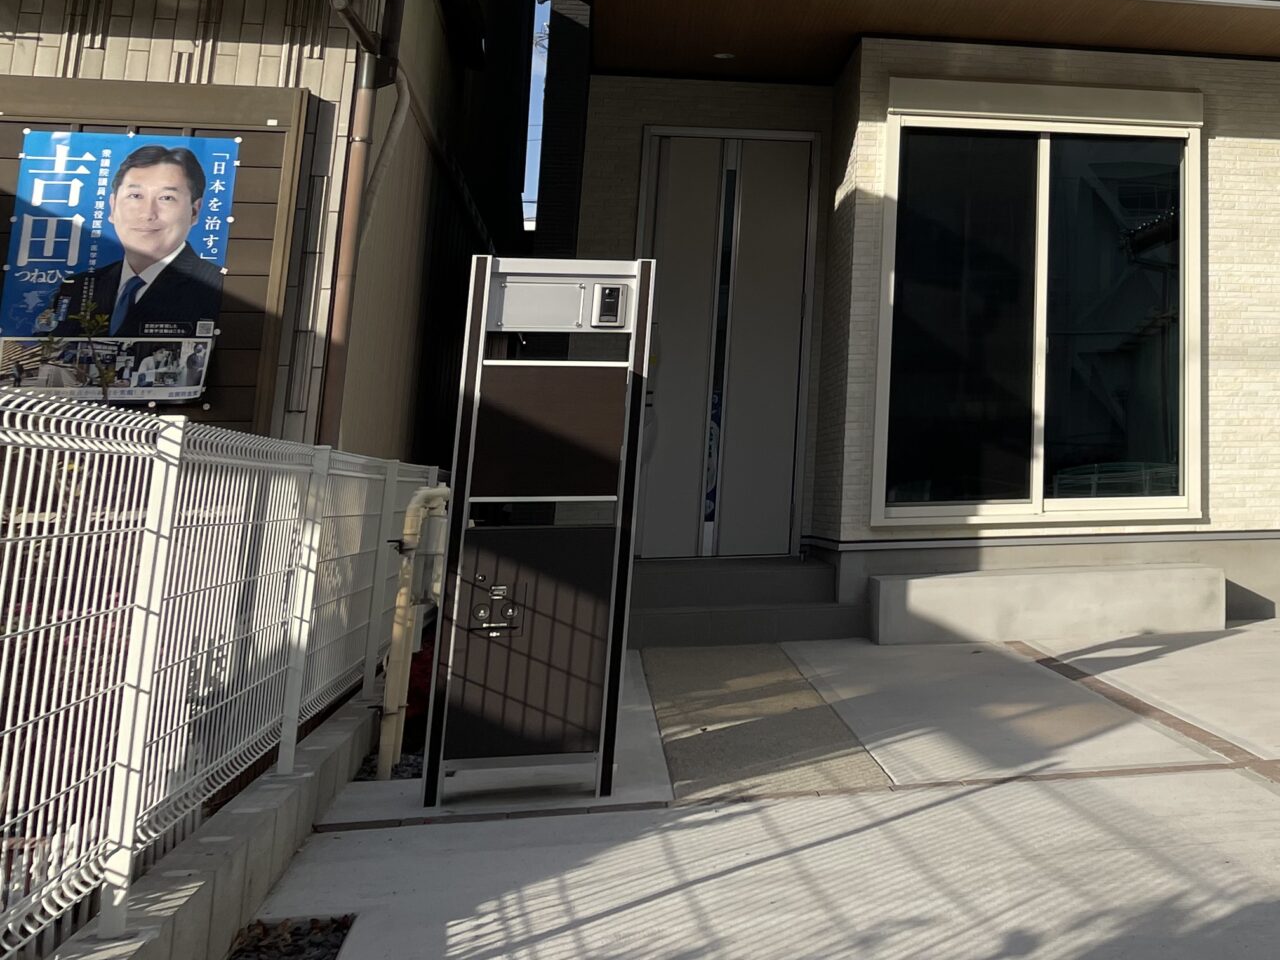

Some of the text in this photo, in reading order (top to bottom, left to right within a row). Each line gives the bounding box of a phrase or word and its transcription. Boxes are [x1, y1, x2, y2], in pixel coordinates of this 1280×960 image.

[16, 144, 97, 267] 吉田
[14, 268, 75, 284] つねひこ
